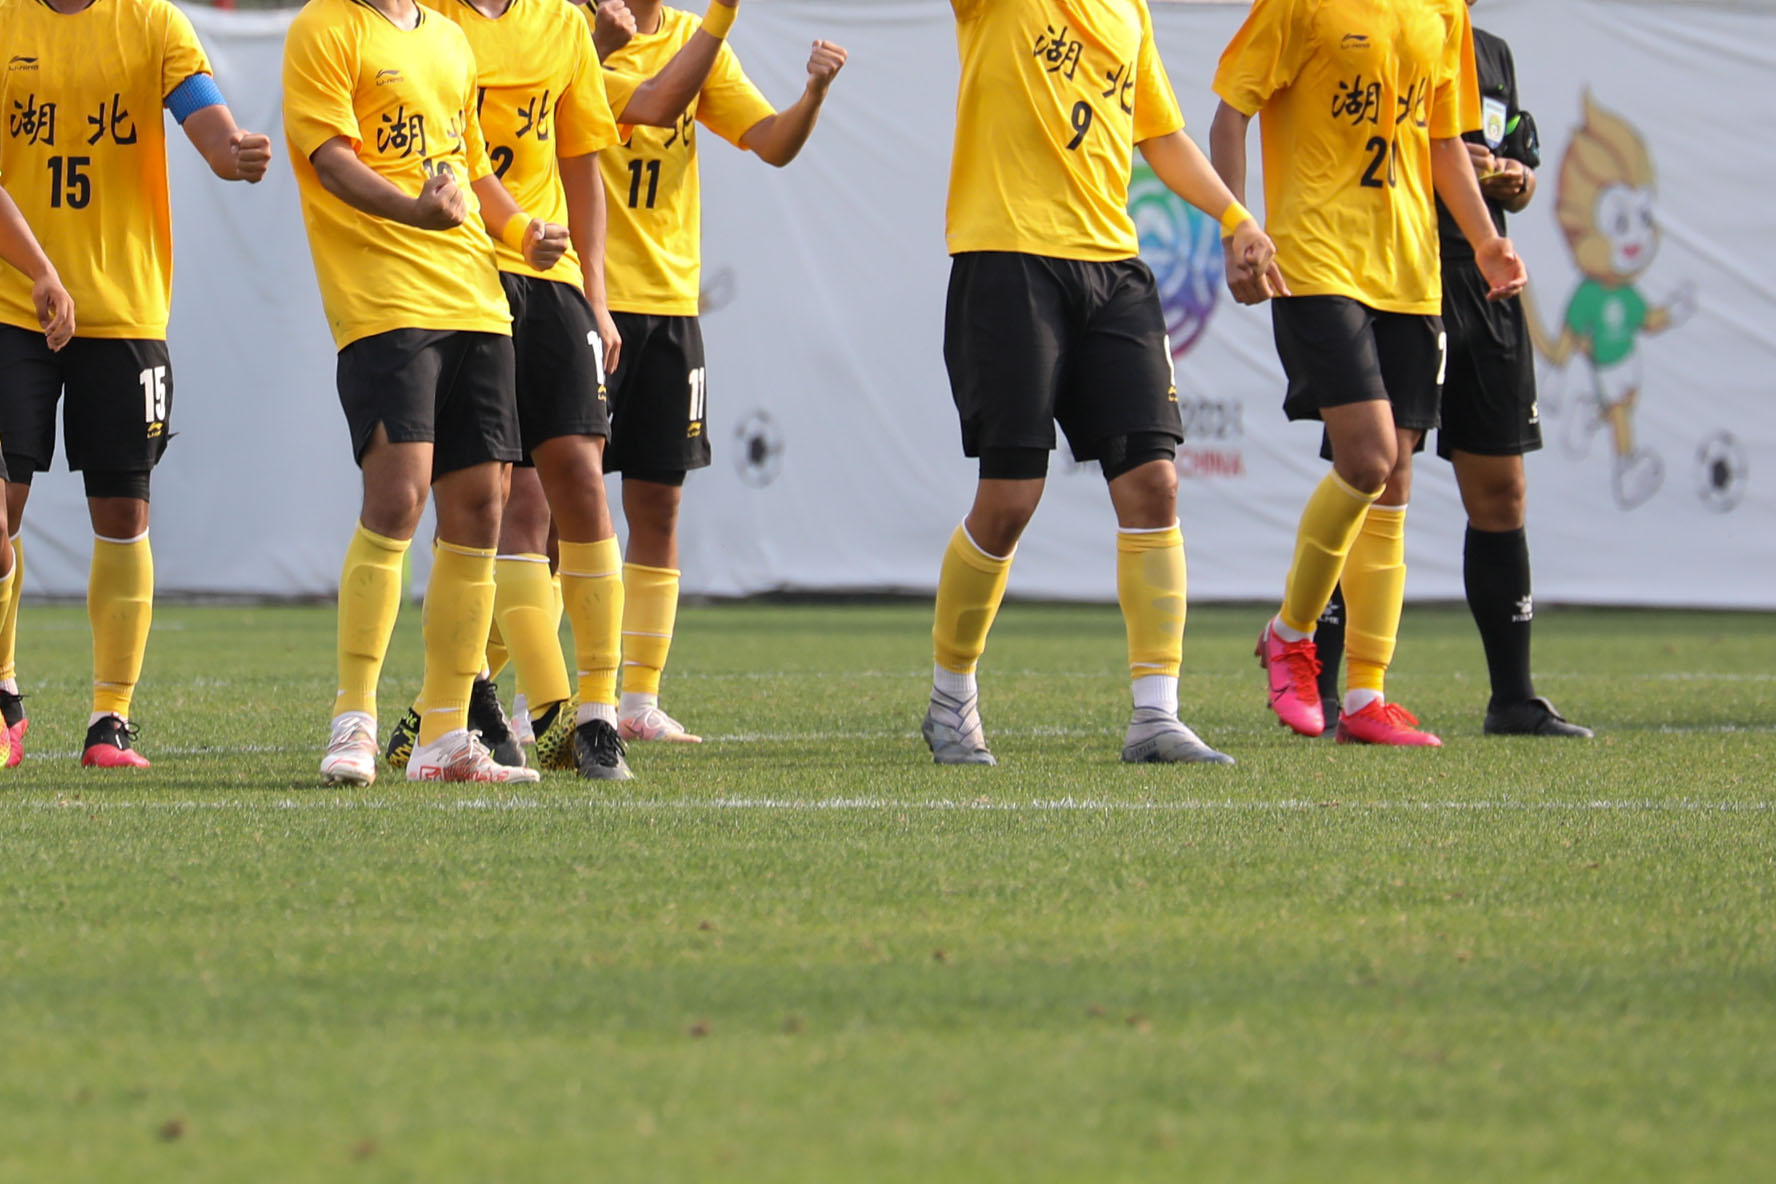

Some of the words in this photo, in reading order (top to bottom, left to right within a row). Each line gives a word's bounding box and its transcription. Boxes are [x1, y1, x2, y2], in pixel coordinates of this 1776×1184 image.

[10, 92, 138, 147] 湖北
[1066, 100, 1093, 151] 9
[47, 155, 91, 210] 15
[628, 157, 662, 210] 11
[139, 365, 166, 423] 15
[688, 366, 705, 421] 11
